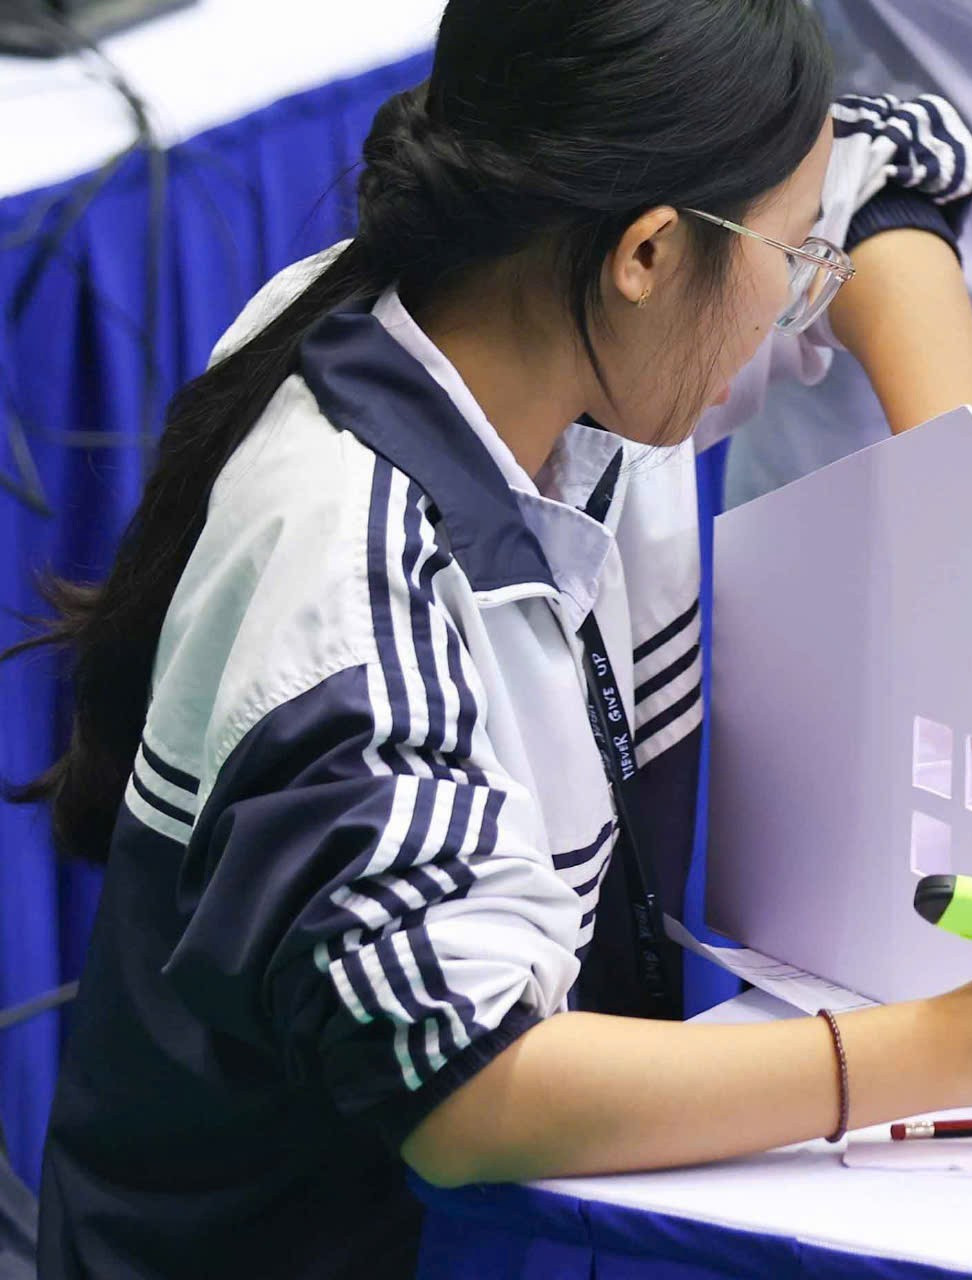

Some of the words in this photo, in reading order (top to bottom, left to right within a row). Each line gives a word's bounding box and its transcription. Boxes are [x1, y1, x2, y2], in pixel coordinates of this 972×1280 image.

[592, 653, 607, 676] UP
[603, 686, 622, 722] GIVE
[613, 732, 635, 780] NEVER
